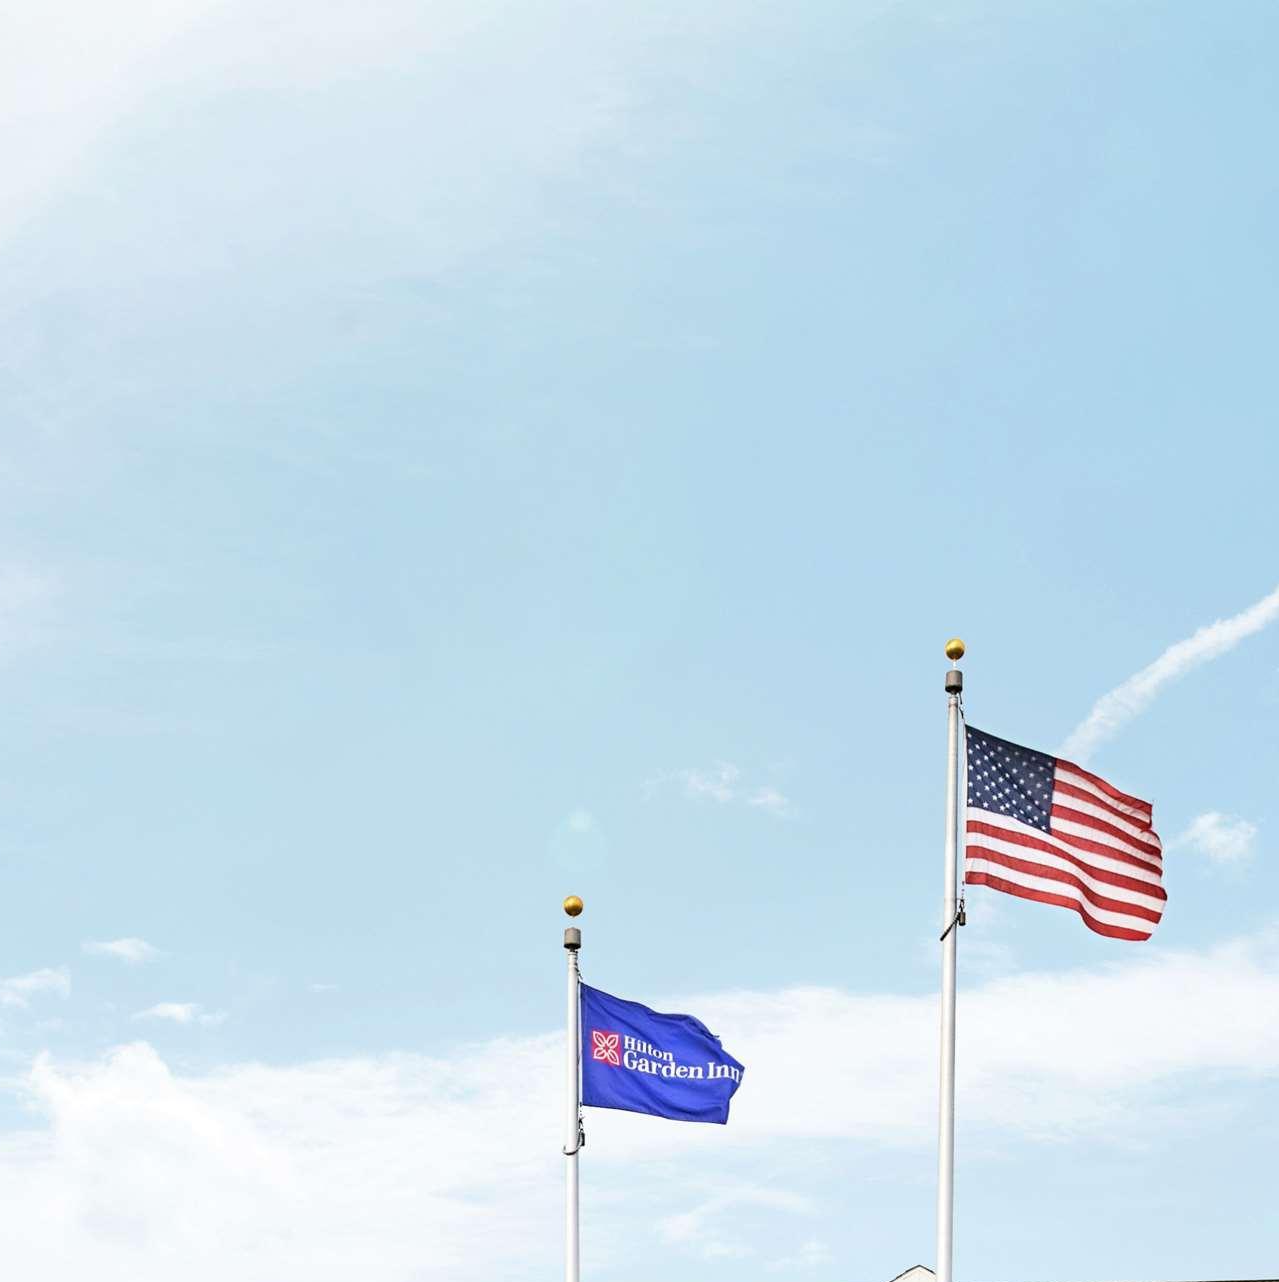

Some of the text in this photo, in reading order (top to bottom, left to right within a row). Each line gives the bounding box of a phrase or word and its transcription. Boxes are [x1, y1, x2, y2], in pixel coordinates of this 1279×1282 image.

[624, 1035, 674, 1062] Hilton
[623, 1051, 740, 1083] Garden Inn
